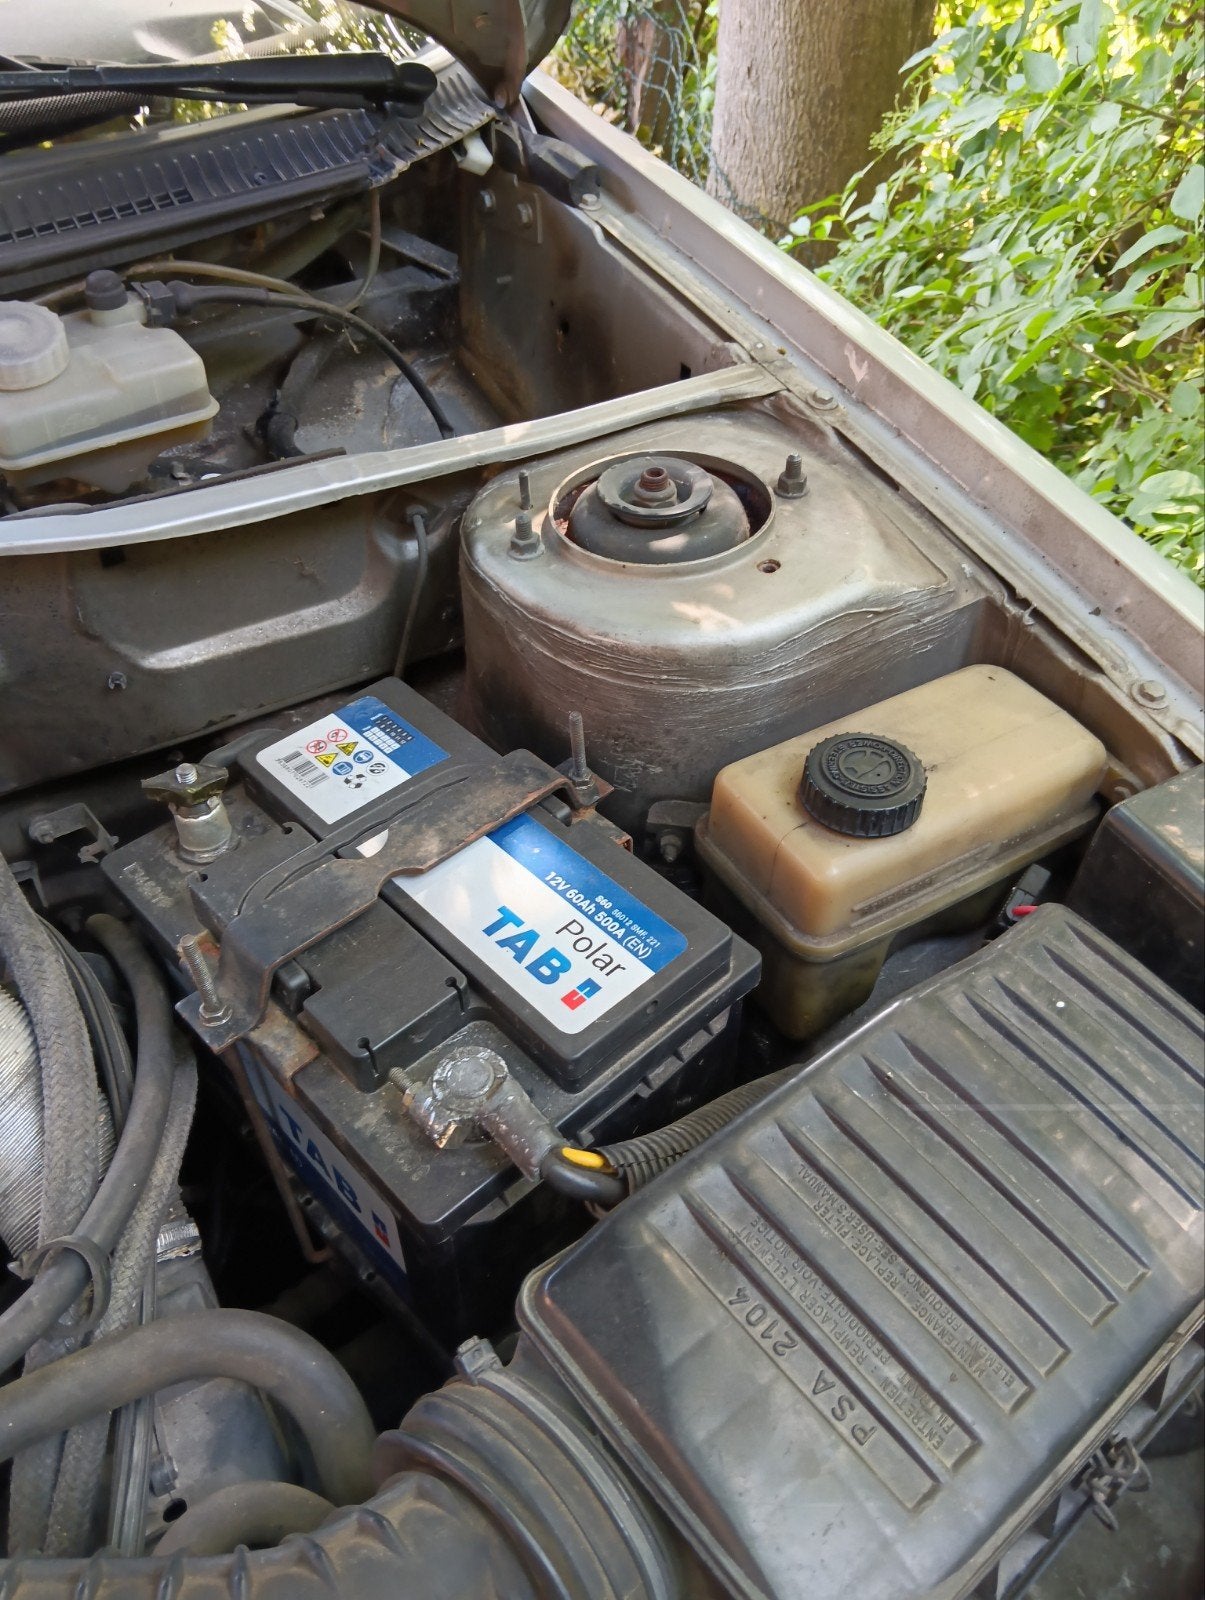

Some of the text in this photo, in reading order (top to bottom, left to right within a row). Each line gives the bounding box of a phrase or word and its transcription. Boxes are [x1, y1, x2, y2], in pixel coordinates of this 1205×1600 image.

[482, 906, 572, 984] TAB
[544, 871, 653, 959] 12V 60Ah 500A (EN)
[555, 918, 627, 977] Polar
[279, 1104, 362, 1214] TAB
[793, 1161, 845, 1212] MANUAL
[734, 1224, 800, 1291] L'ELEMENT
[750, 1215, 794, 1258] NOTICE
[796, 1289, 871, 1366] REMPLACER
[727, 1285, 879, 1447] PSA 2104
[878, 1377, 945, 1450] ENTRETIEN
